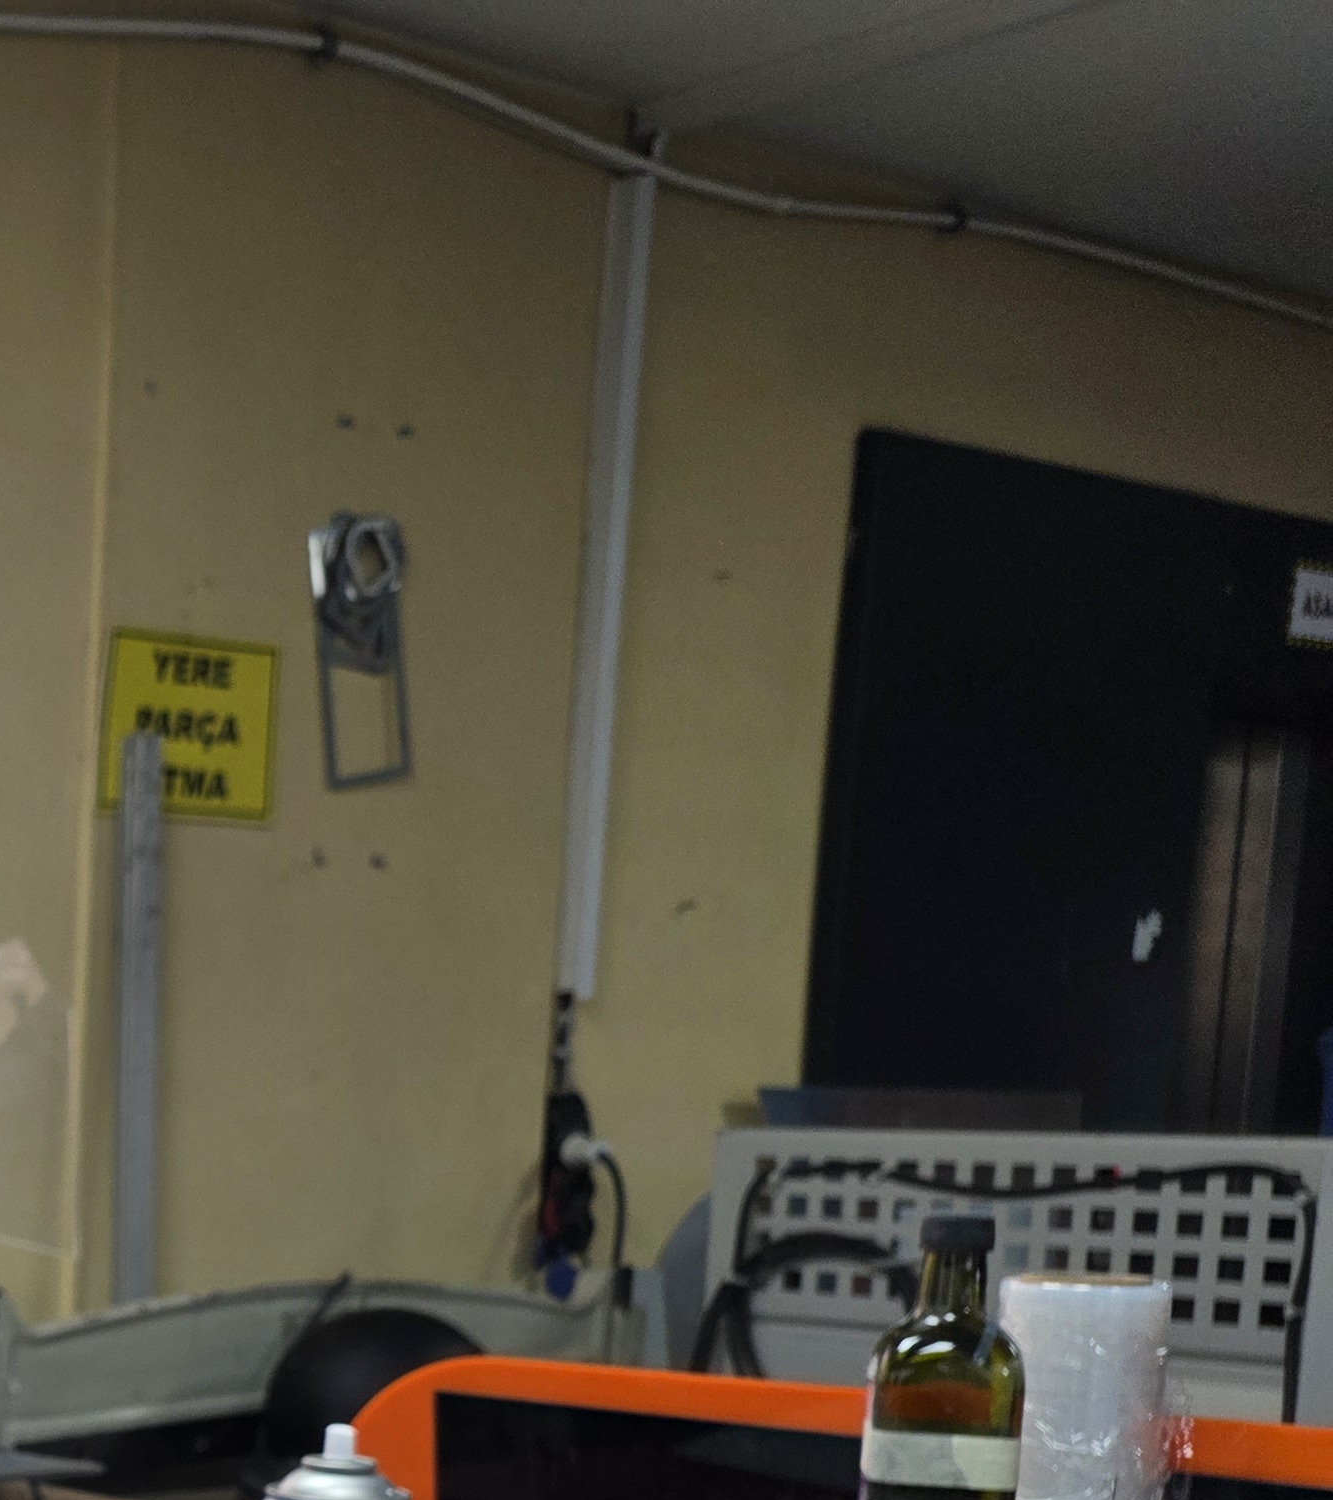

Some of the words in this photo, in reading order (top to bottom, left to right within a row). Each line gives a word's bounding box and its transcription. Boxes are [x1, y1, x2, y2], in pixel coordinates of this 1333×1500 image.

[153, 651, 232, 690] YERE
[135, 705, 241, 752] PARÇA
[163, 764, 228, 799] TMA
